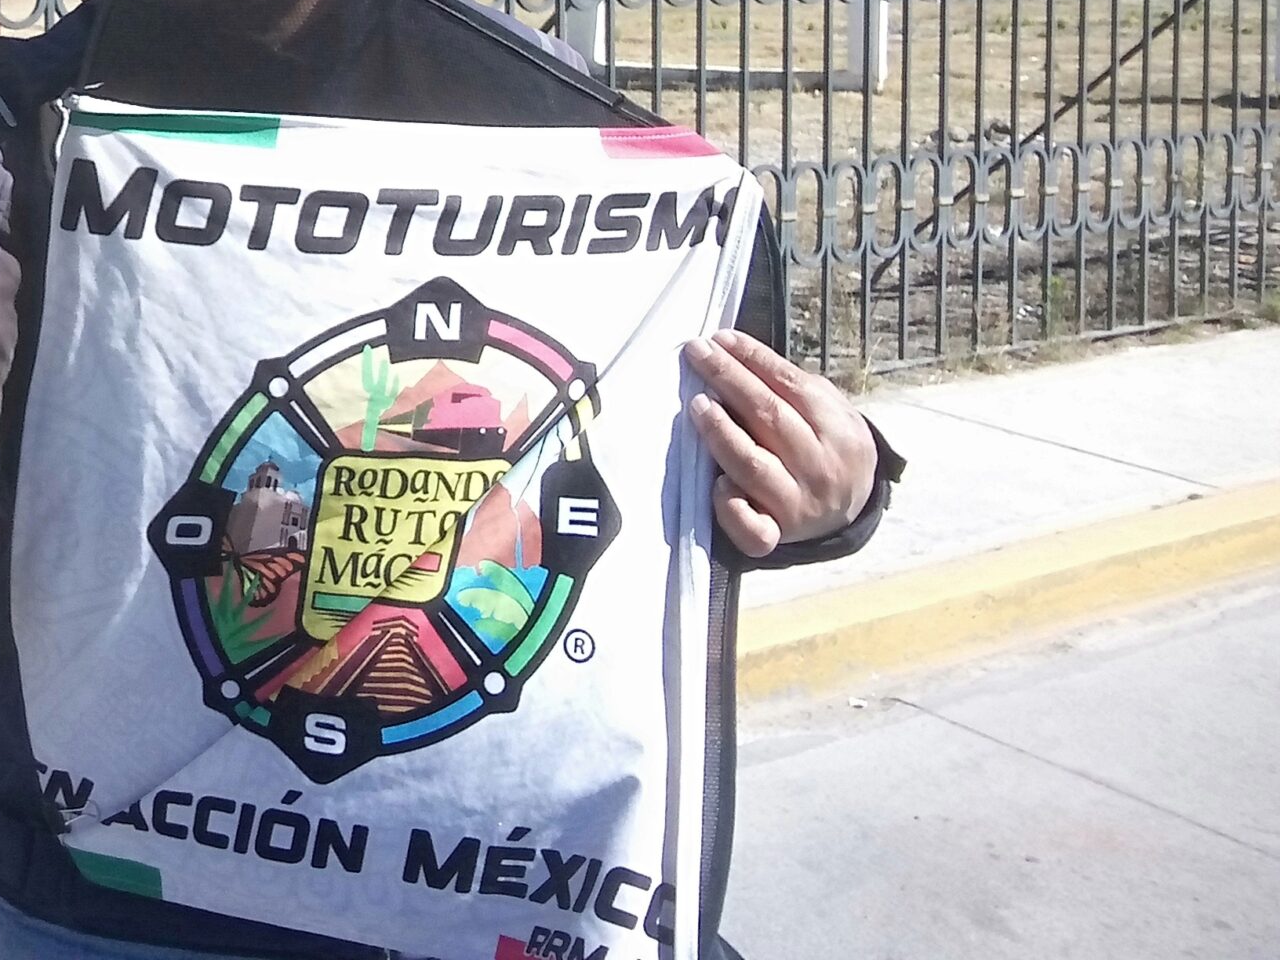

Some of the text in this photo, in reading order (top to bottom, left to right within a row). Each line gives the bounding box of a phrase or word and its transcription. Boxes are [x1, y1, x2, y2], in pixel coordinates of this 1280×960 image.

[413, 301, 462, 341] N
[556, 497, 600, 535] E
[304, 712, 348, 756] S
[34, 762, 95, 816] N
